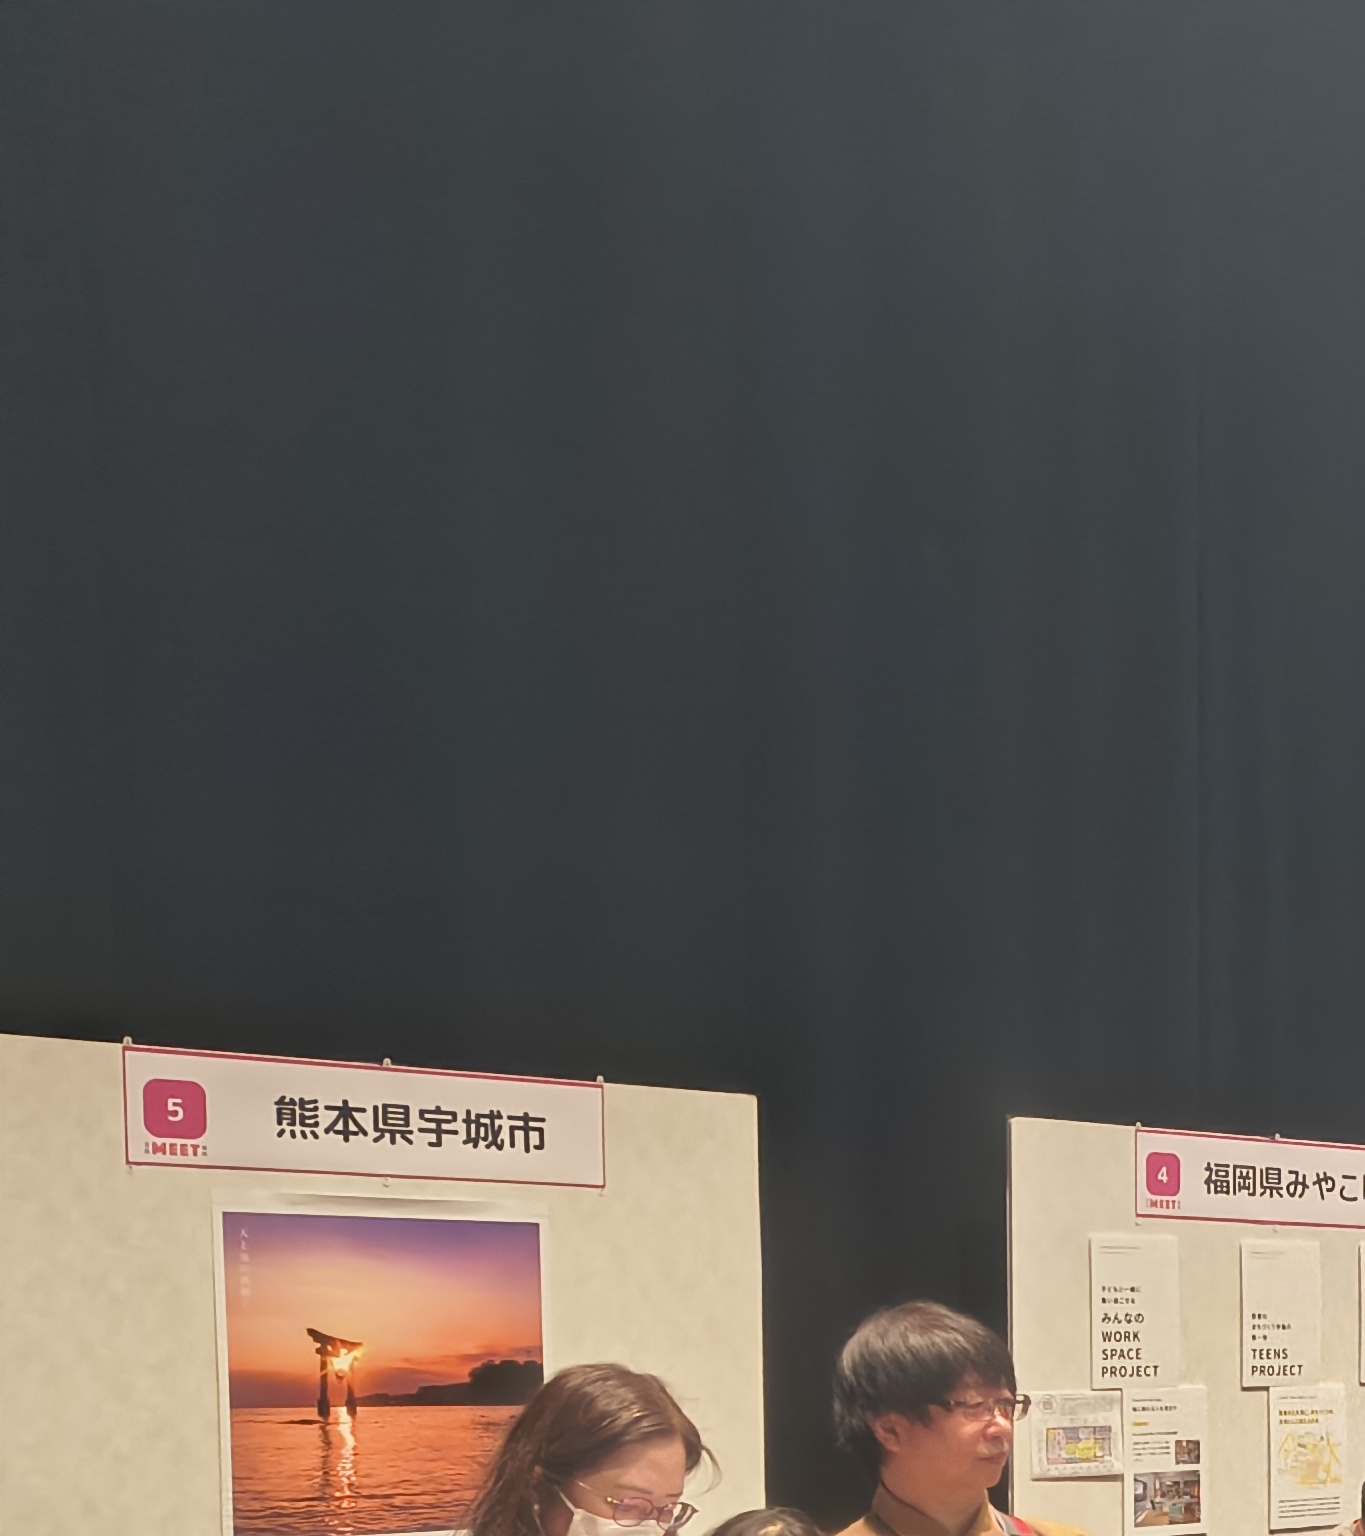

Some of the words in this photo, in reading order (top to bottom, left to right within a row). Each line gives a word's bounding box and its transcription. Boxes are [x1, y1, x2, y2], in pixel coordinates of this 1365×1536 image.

[166, 1098, 184, 1122] 5
[273, 1094, 547, 1154] 熊本県宇城市
[1157, 1166, 1168, 1184] 4
[1101, 1312, 1145, 1325] みんなの
[1101, 1330, 1141, 1343] WORK
[1101, 1347, 1142, 1361] SPACE
[1250, 1347, 1289, 1361] TEENS
[1101, 1364, 1160, 1378] PROJECT
[1251, 1364, 1303, 1377] PROJECT
